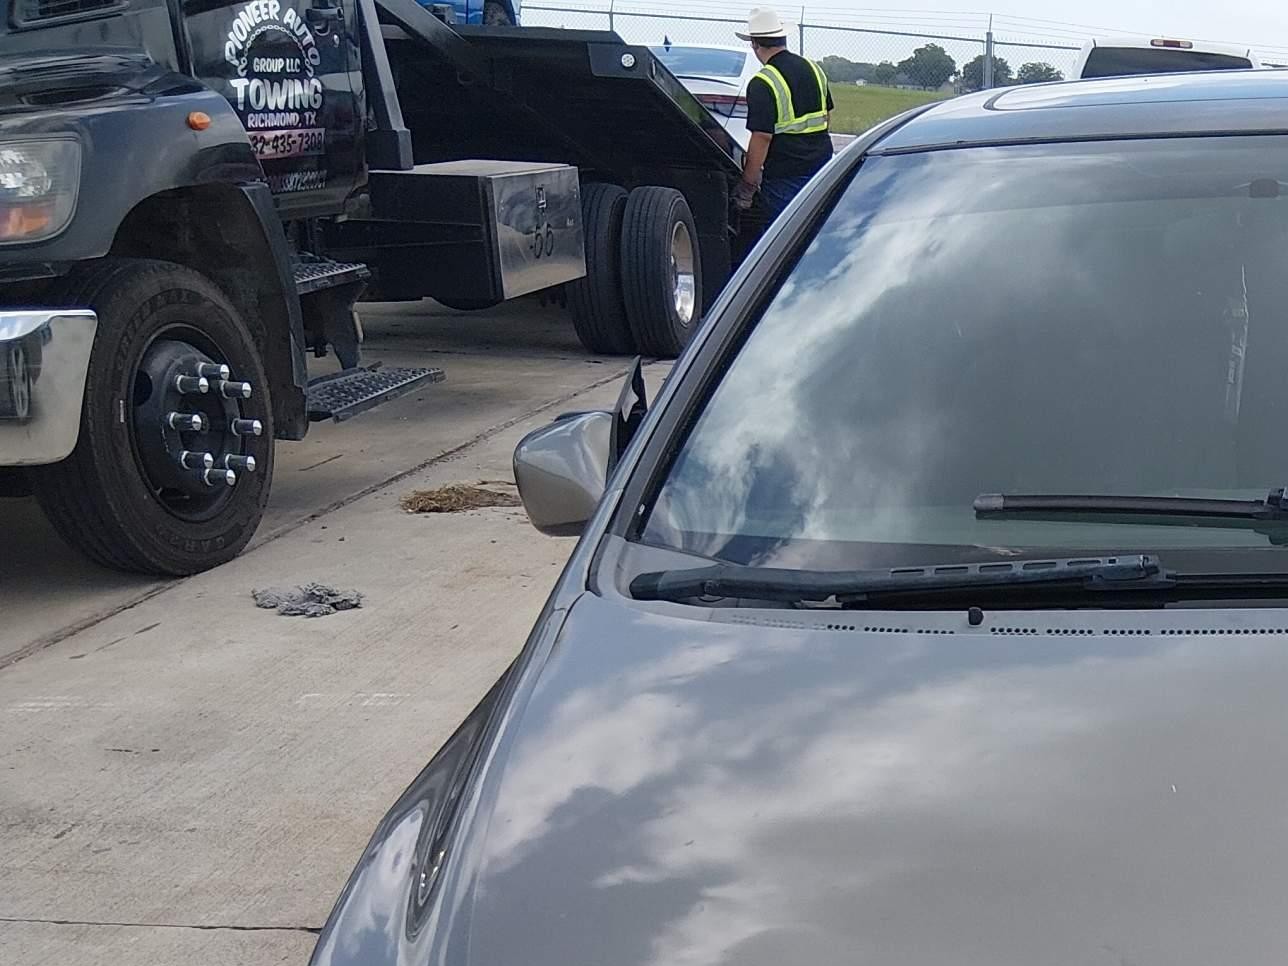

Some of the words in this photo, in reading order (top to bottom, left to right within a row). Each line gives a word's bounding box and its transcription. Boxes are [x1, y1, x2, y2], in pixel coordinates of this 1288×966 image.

[225, 0, 281, 66] PIONEER
[283, 8, 320, 66] AUTO
[253, 58, 283, 73] GROUP
[286, 58, 301, 72] LLC
[229, 78, 323, 111] TOWING
[247, 113, 302, 128] RICHMOND,
[304, 112, 317, 126] TX
[249, 132, 324, 155] 32-435-7308
